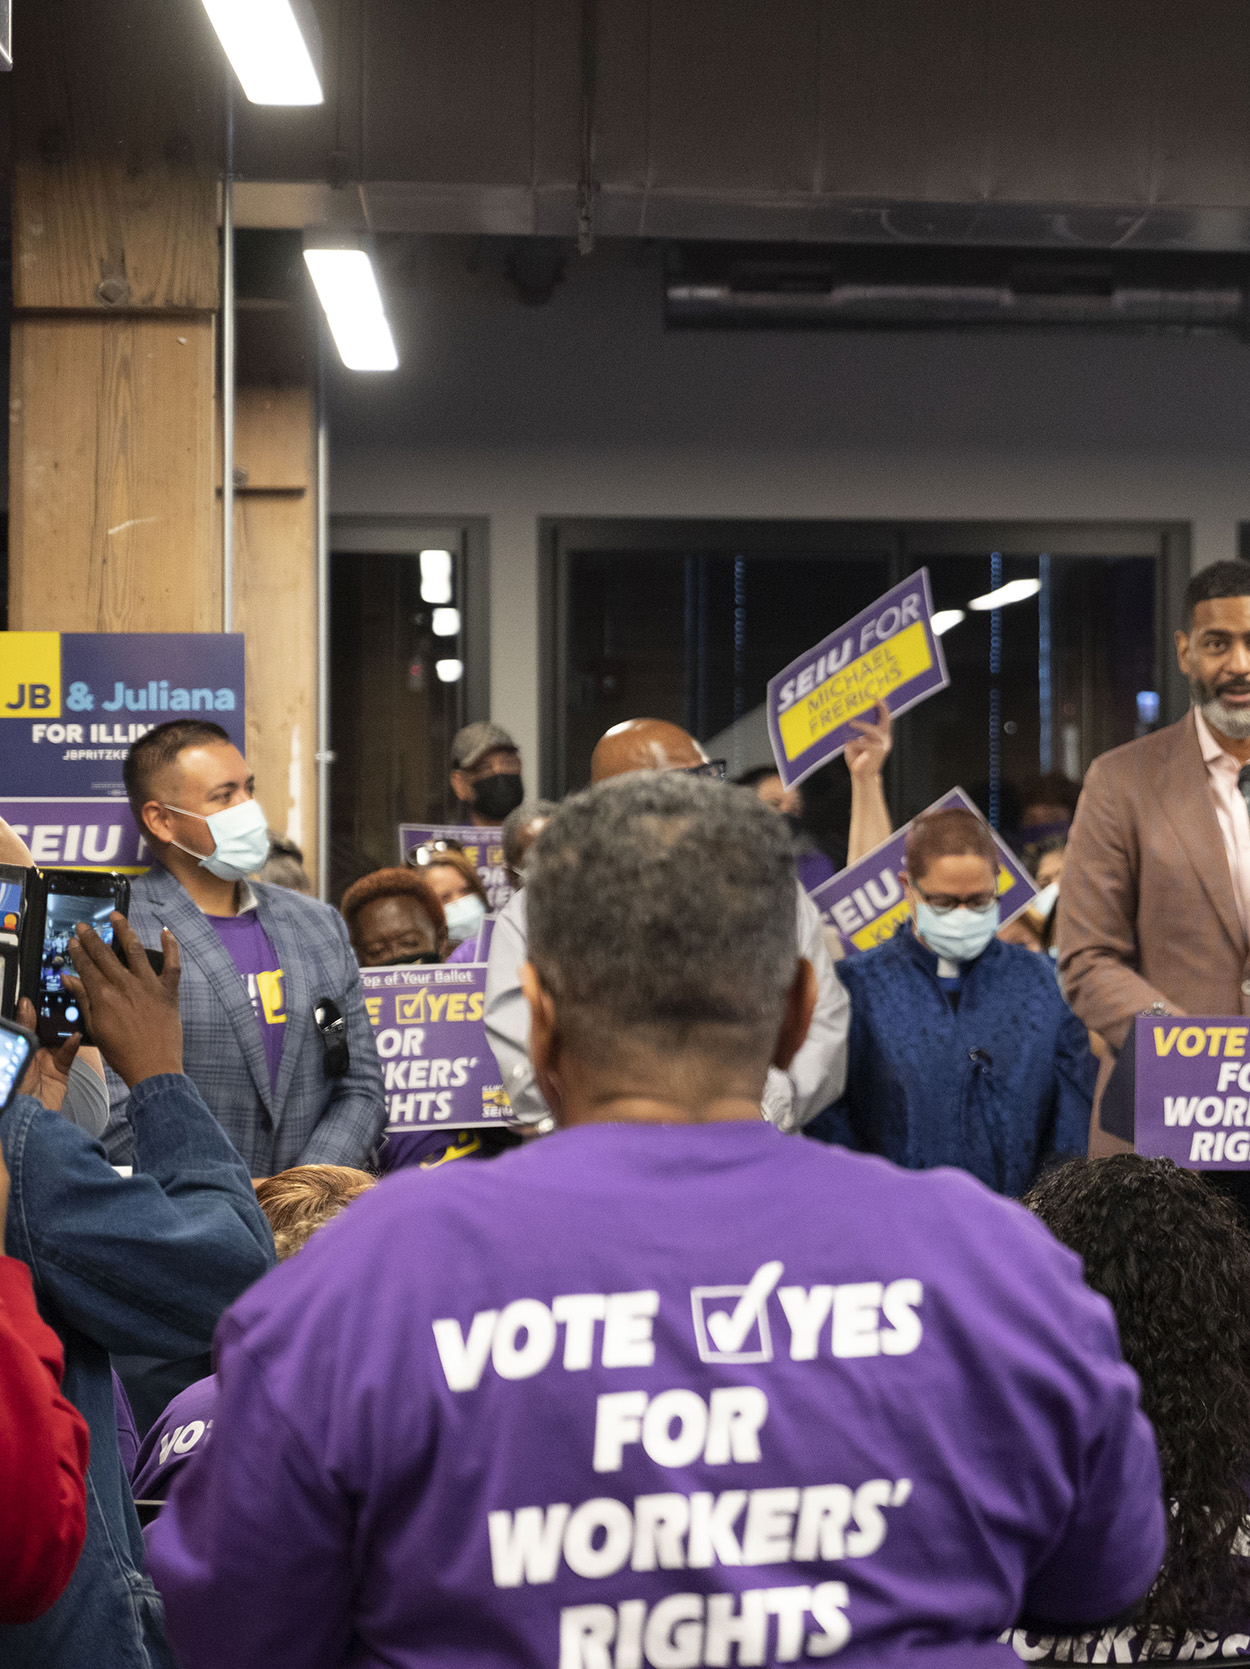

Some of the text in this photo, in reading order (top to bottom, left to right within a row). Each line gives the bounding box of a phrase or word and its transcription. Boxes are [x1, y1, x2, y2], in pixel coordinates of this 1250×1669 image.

[777, 592, 922, 713] SEIU FOR
[806, 648, 896, 716] MICHAEL
[6, 680, 235, 712] JB & Juliana
[808, 660, 903, 738] FRERICHS
[32, 723, 83, 744] FOR
[820, 867, 900, 934] EIU
[384, 971, 398, 986] of
[401, 970, 431, 985] Your
[434, 968, 473, 984] Ballot
[426, 992, 485, 1023] YES
[374, 1027, 425, 1059] OR
[381, 1056, 478, 1091] KERS'
[1153, 1026, 1249, 1058] VOTE
[432, 1278, 924, 1393] VOTE YES
[592, 1385, 769, 1473] FOR
[487, 1477, 914, 1589] WORKERS'
[557, 1580, 853, 1669] RIGHTS
